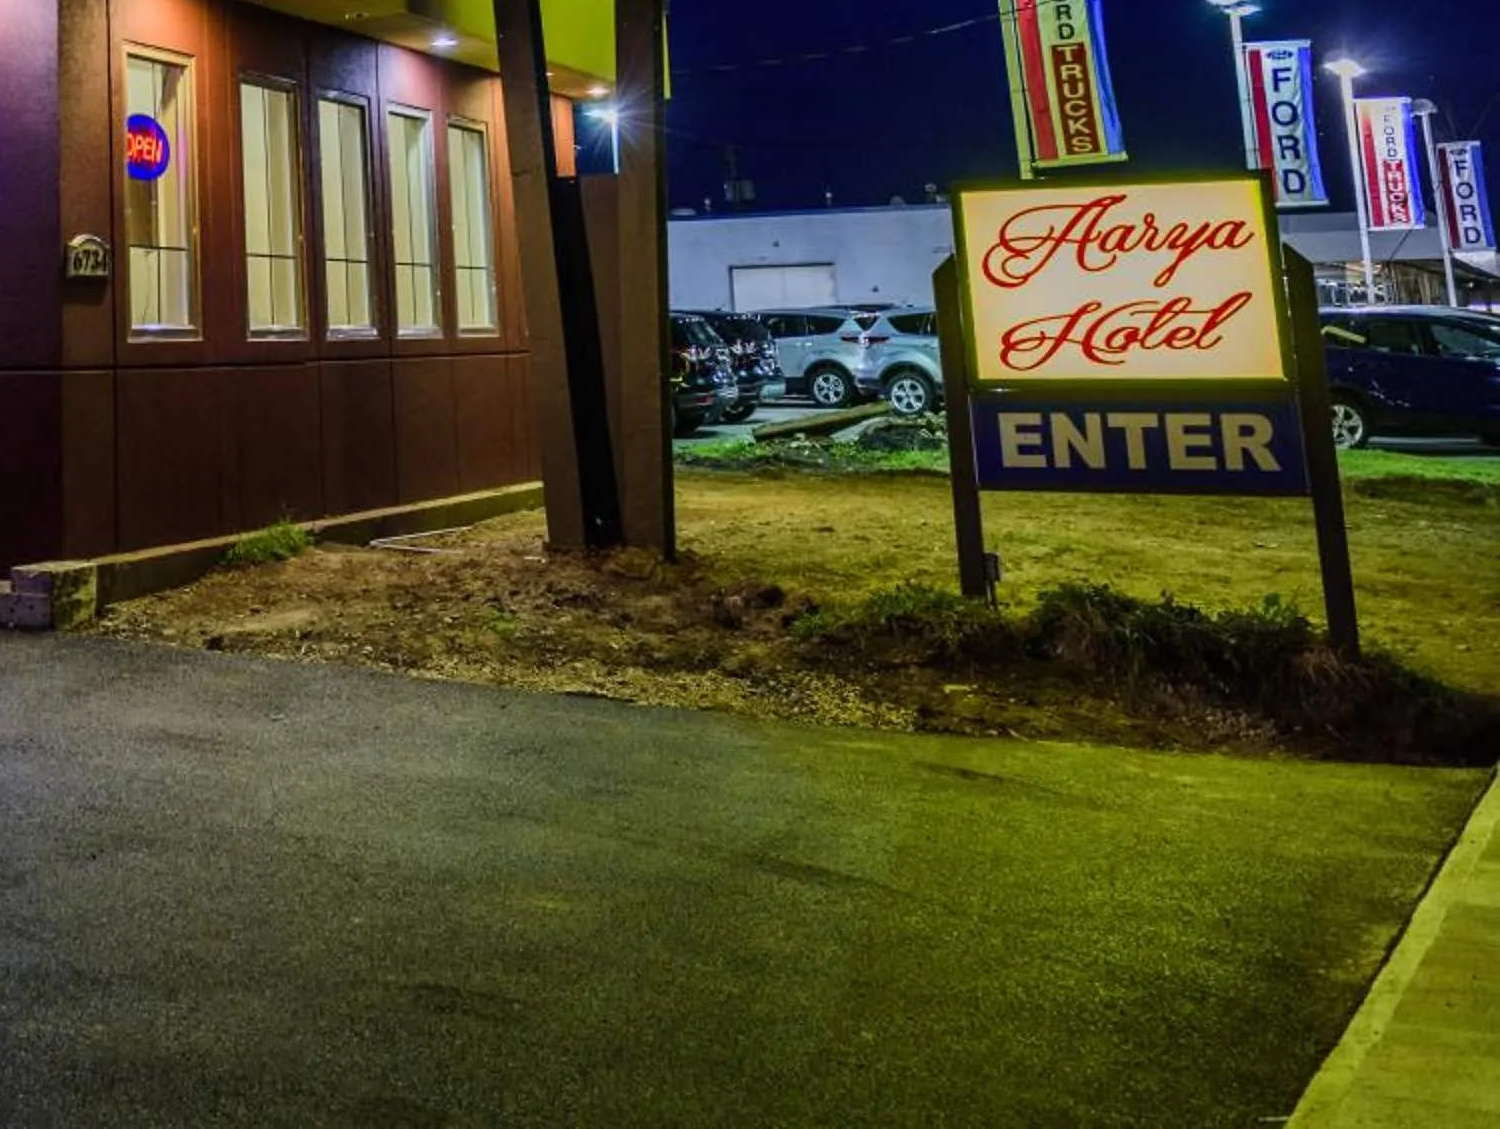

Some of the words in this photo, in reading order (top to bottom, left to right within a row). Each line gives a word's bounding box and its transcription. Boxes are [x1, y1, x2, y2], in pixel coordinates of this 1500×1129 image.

[1056, 46, 1094, 153] TRUCKS
[1271, 67, 1306, 194] FORD
[1383, 114, 1398, 158] FORD
[127, 132, 163, 163] OPEN
[983, 194, 1255, 288] Aarya
[1454, 160, 1482, 243] FORD
[1000, 292, 1253, 371] Hotel
[997, 412, 1281, 472] ENTER
